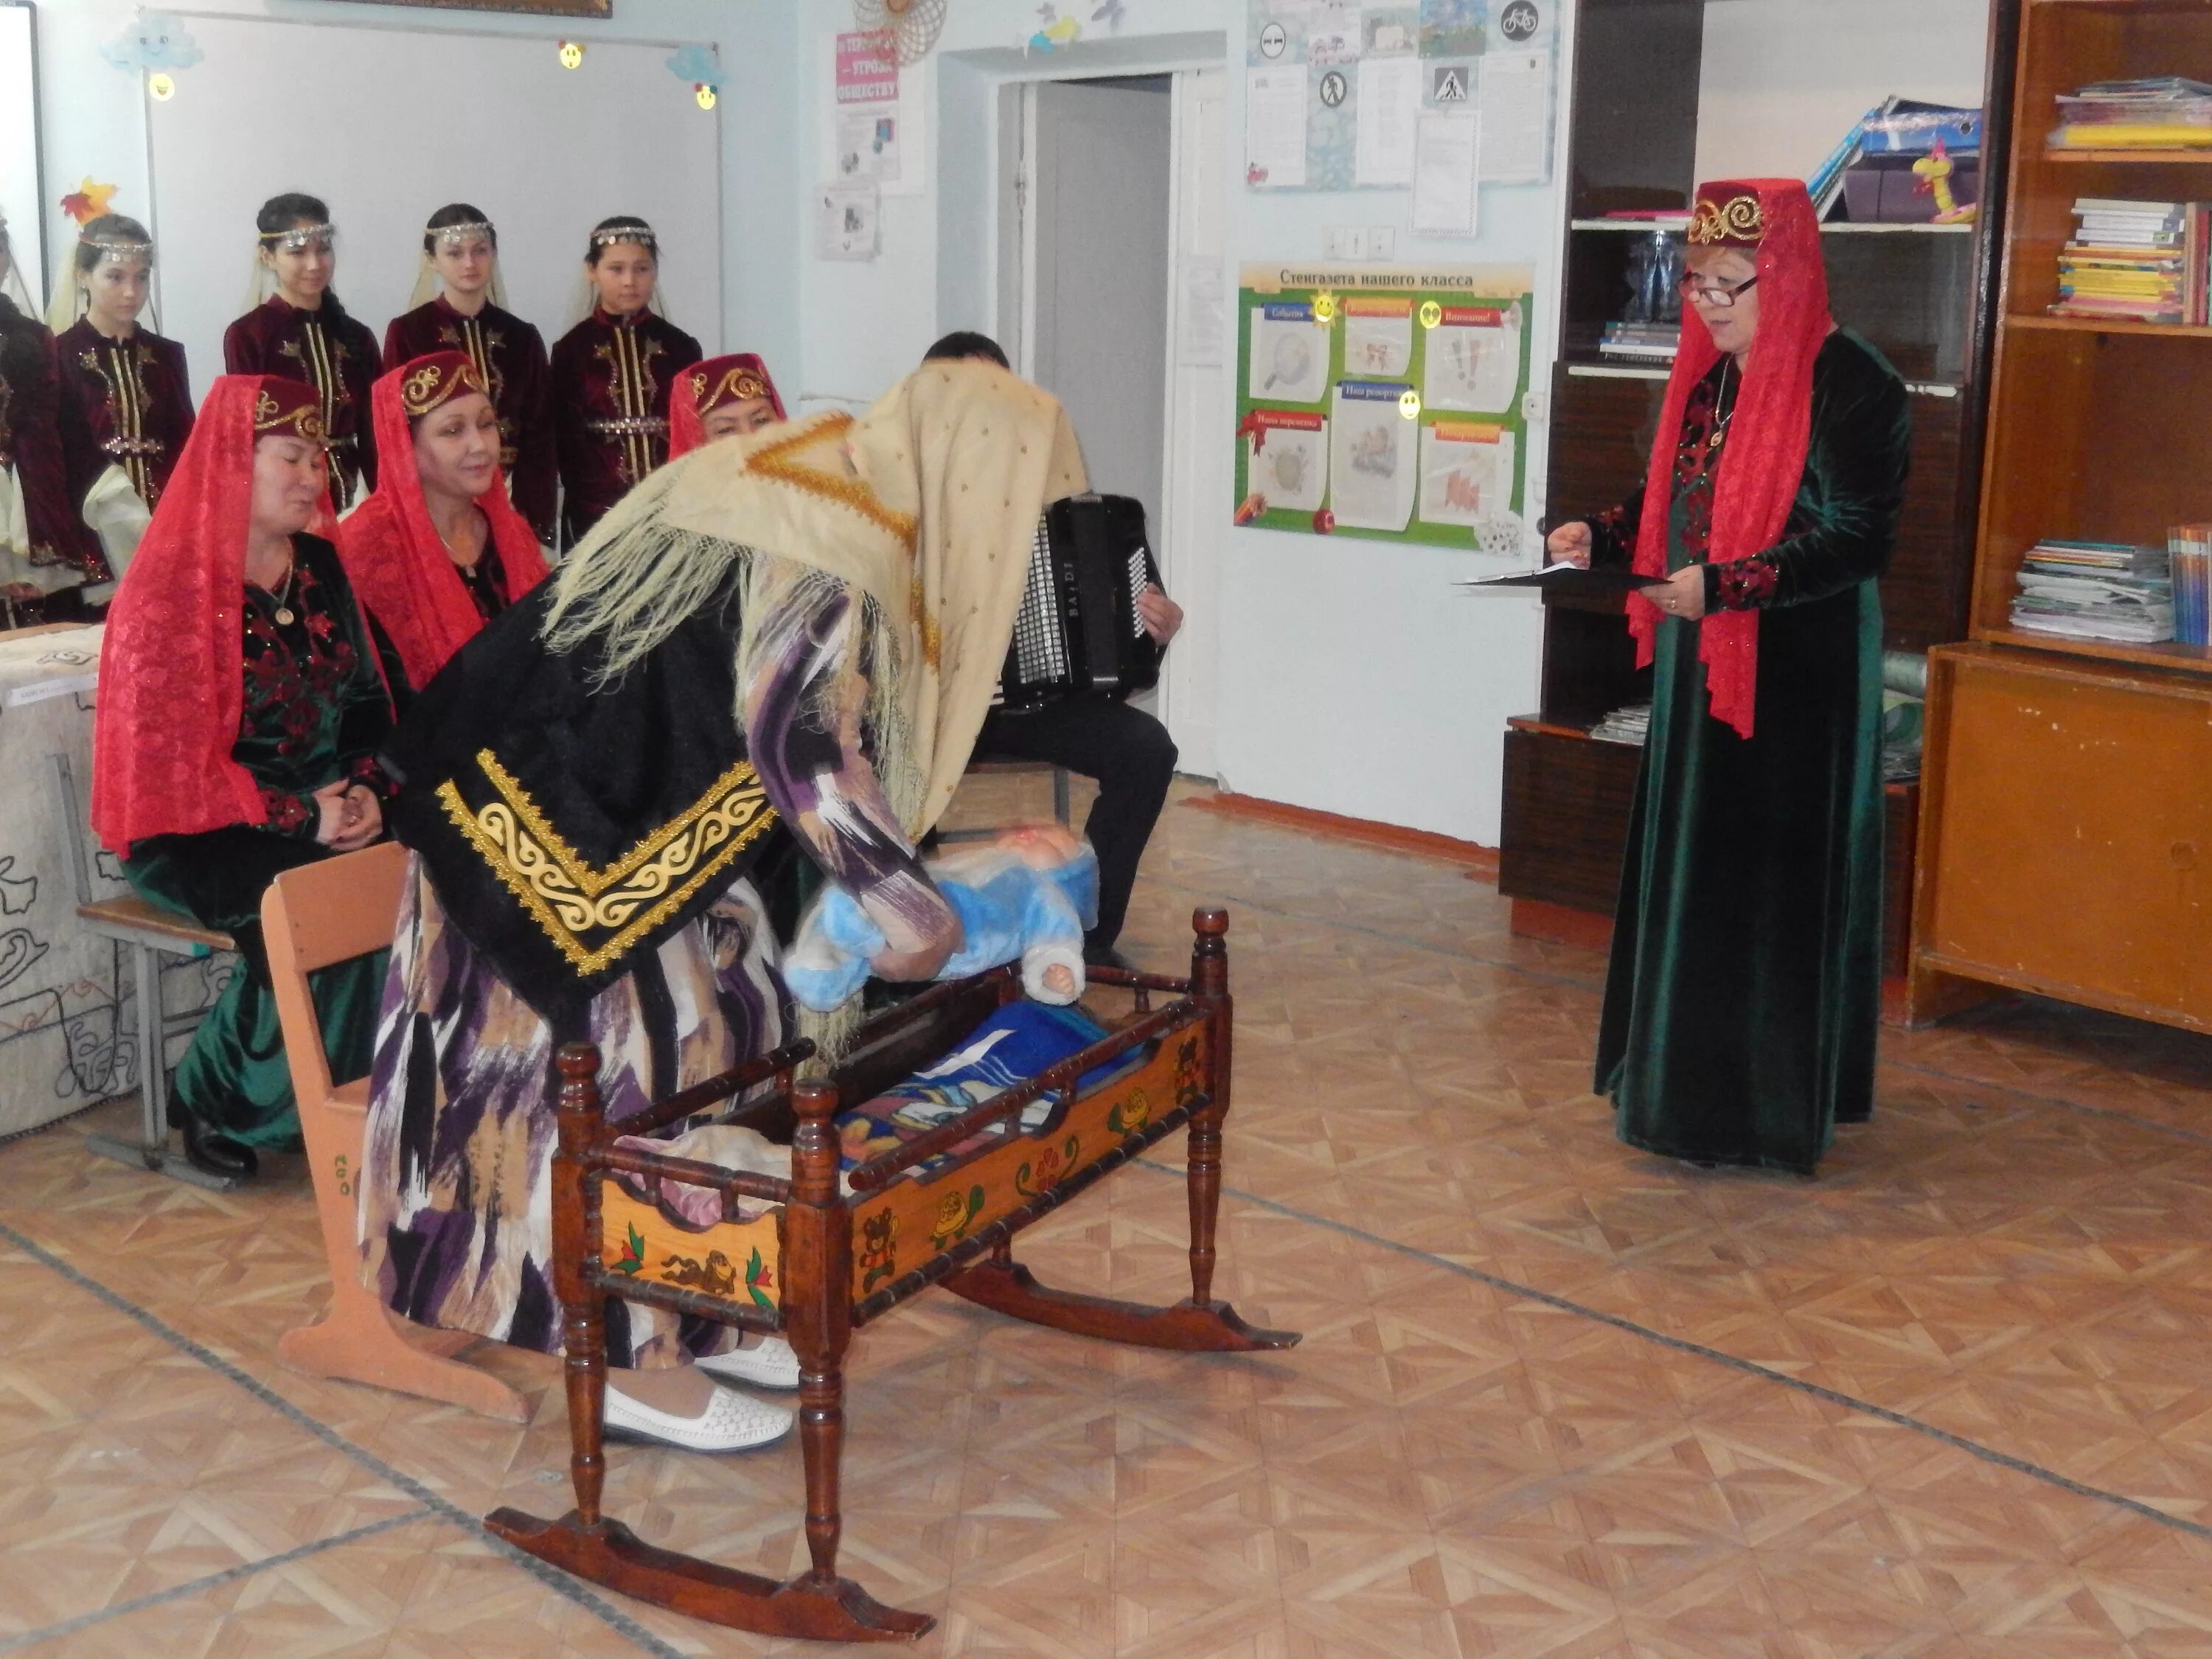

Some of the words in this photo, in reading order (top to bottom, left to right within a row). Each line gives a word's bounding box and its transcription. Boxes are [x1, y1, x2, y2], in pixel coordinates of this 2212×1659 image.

[838, 83, 895, 100] ОБЩЕСТВУ
[1280, 269, 1355, 285] Стенгазета
[1361, 274, 1415, 287] нашего
[1421, 274, 1473, 287] класса
[1445, 311, 1490, 322] Внимание!
[1346, 385, 1365, 396] Наш
[1366, 389, 1401, 399] репорт
